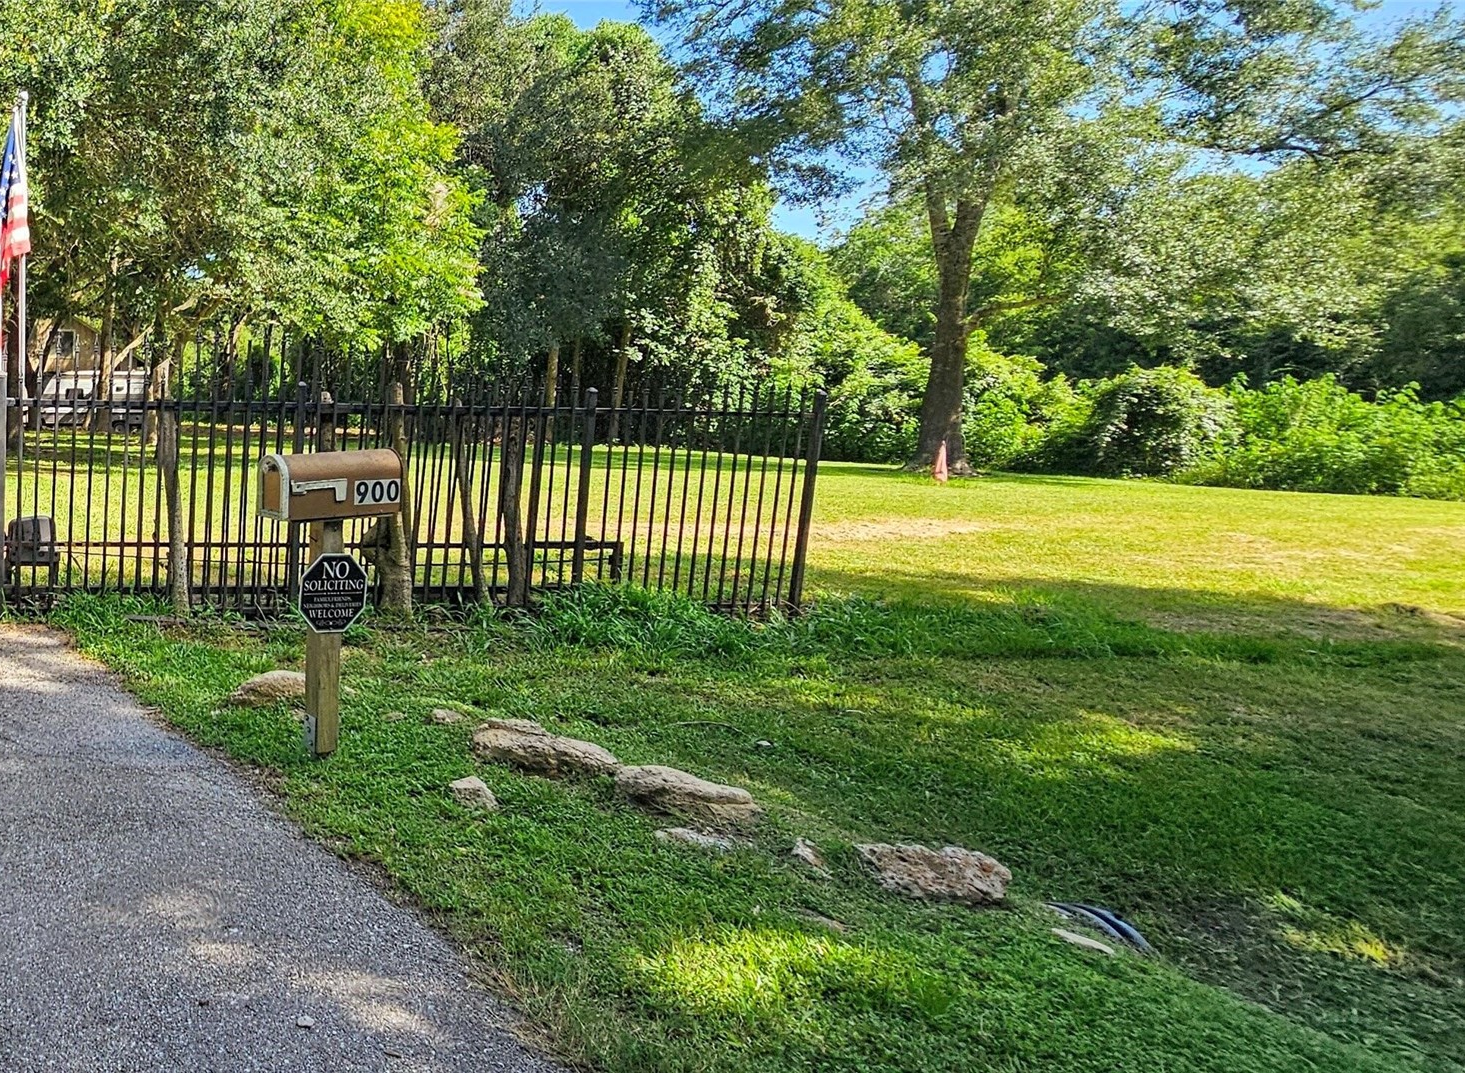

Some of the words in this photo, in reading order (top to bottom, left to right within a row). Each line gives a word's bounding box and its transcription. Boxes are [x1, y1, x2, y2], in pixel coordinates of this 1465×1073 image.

[356, 480, 399, 503] 900
[322, 561, 350, 579] NO
[304, 579, 364, 591] SOLICITING
[309, 608, 355, 618] WELCOME
